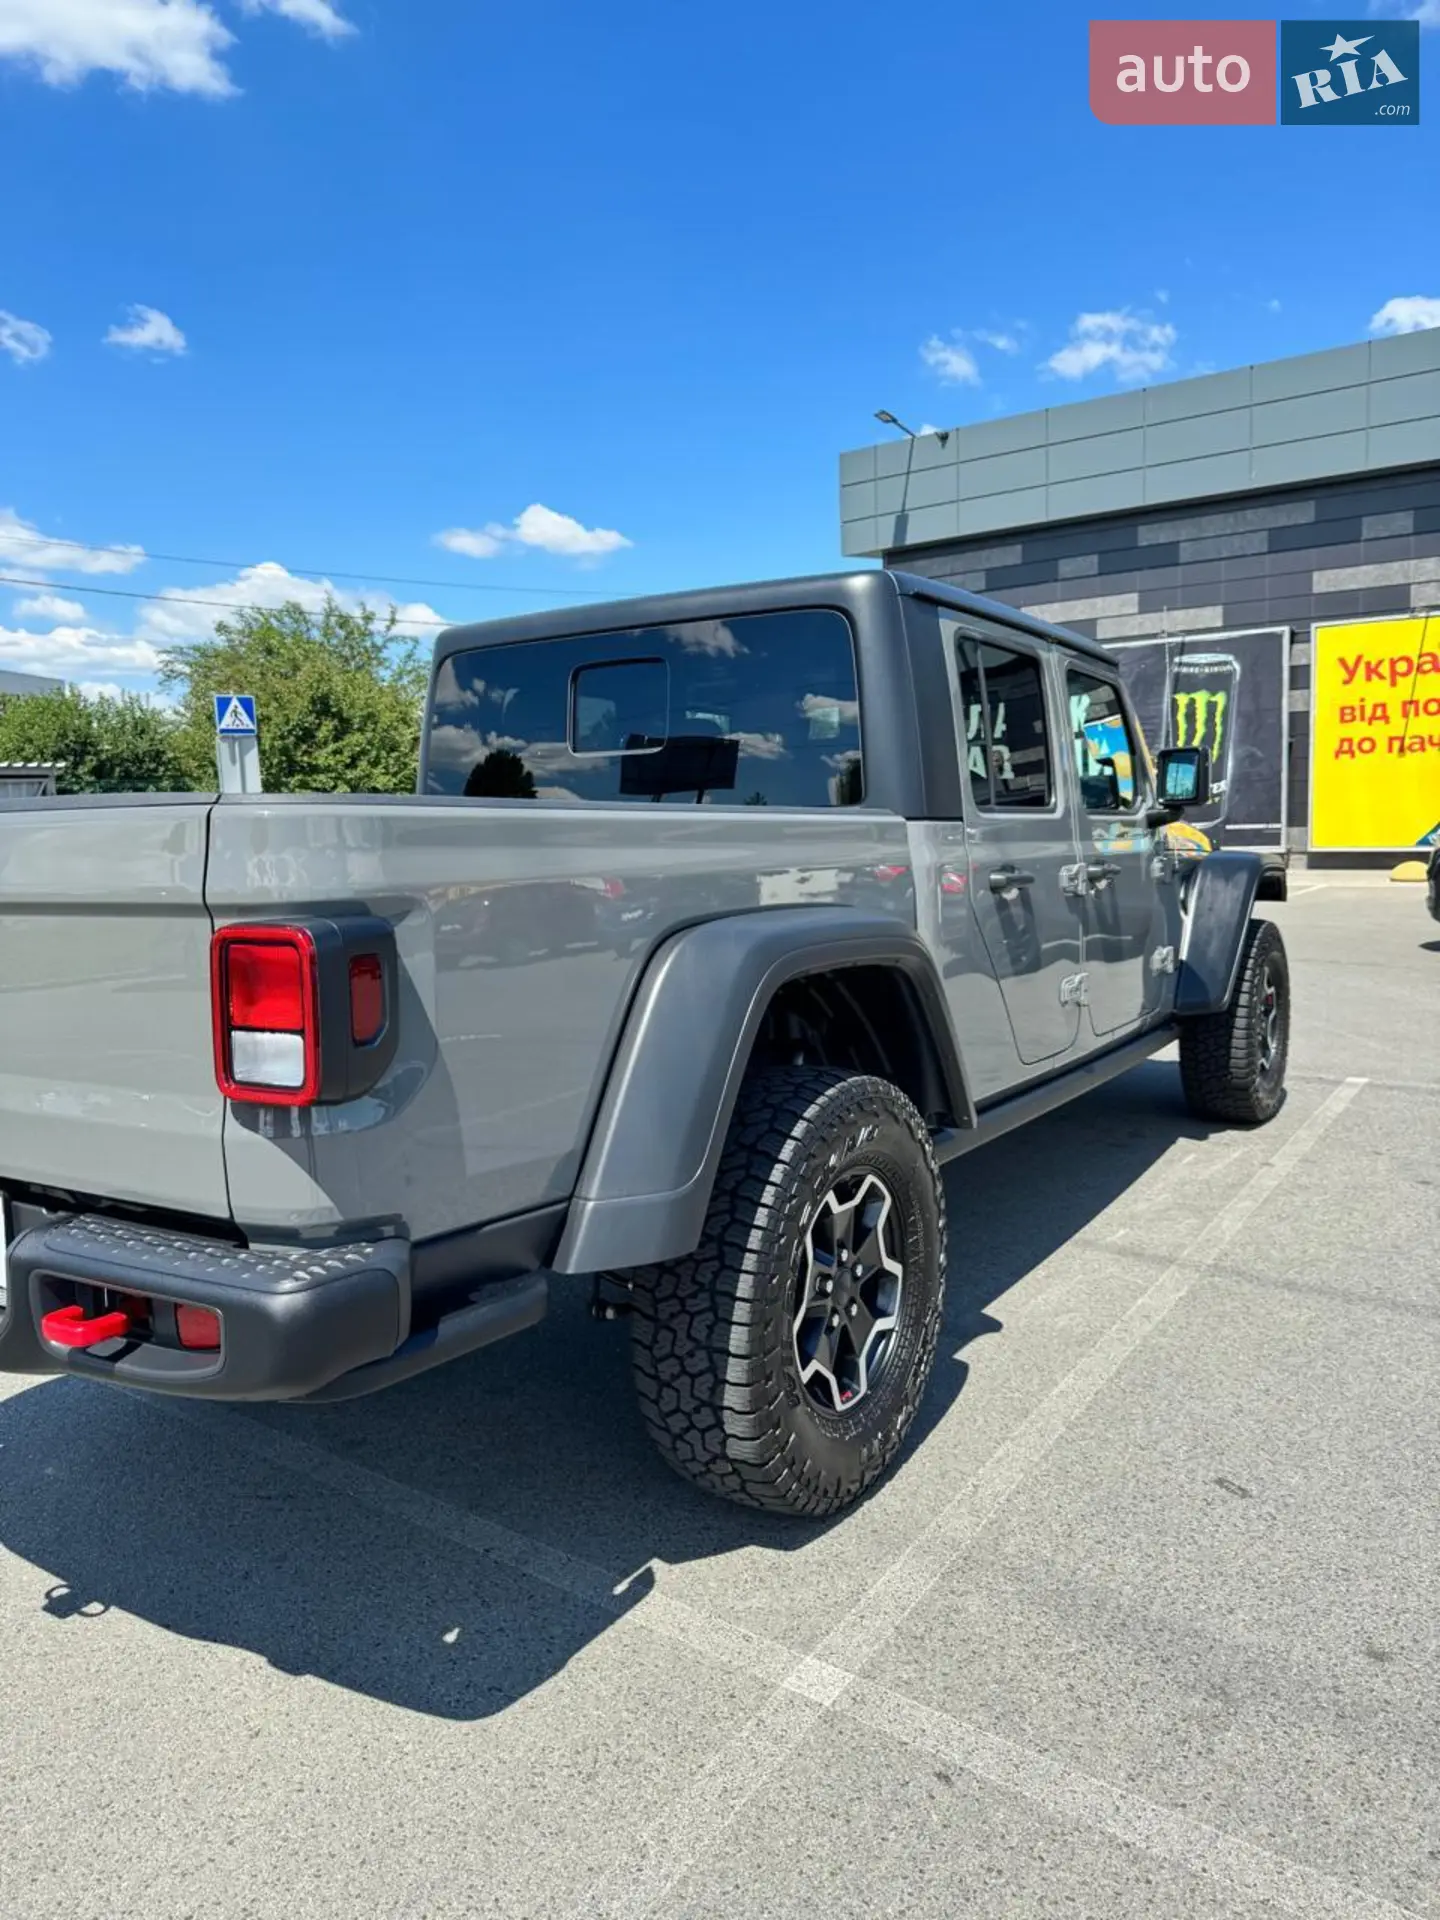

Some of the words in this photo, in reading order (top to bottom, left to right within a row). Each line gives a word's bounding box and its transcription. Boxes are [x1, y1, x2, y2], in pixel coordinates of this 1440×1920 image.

[1338, 651, 1440, 688] Укра
[1340, 698, 1390, 725] від
[1401, 698, 1440, 718] по
[1335, 736, 1377, 760] до
